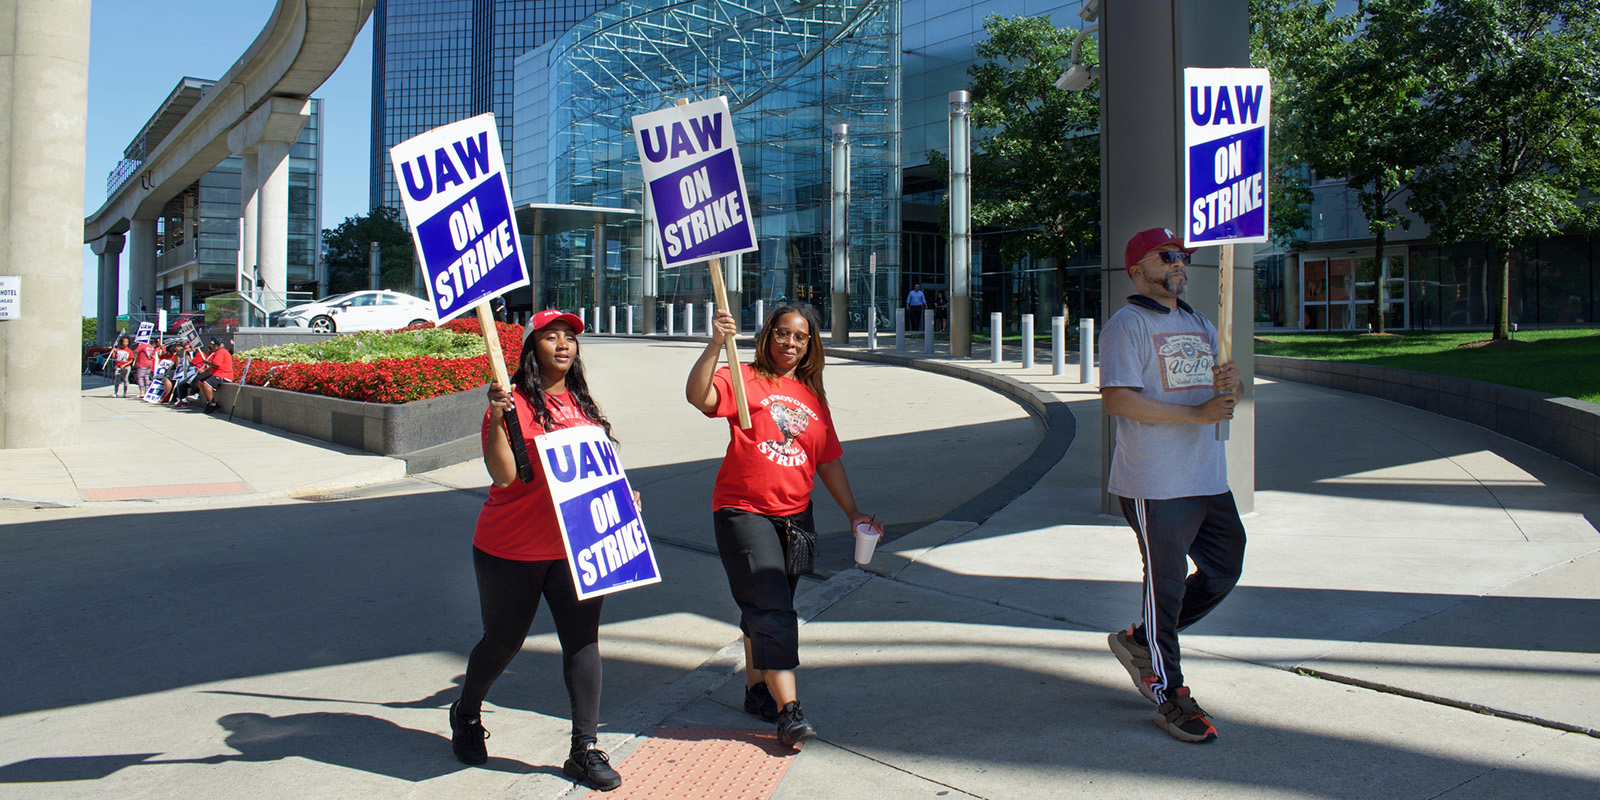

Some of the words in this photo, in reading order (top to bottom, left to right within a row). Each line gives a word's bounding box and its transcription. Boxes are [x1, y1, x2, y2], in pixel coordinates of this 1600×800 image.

[1190, 85, 1264, 126] UAW
[640, 112, 722, 163] UAW
[401, 131, 489, 202] UAW
[1214, 140, 1242, 185] ON
[679, 166, 712, 210] ON
[1192, 172, 1262, 236] STRIKE
[449, 196, 484, 251] ON
[664, 190, 743, 257] STRIKE
[435, 219, 514, 310] STRIKE
[1169, 358, 1212, 374] UAW
[768, 394, 818, 421] PROVOKED
[546, 441, 619, 483] UAW
[590, 490, 621, 534] ON
[577, 518, 646, 586] STRIKE
